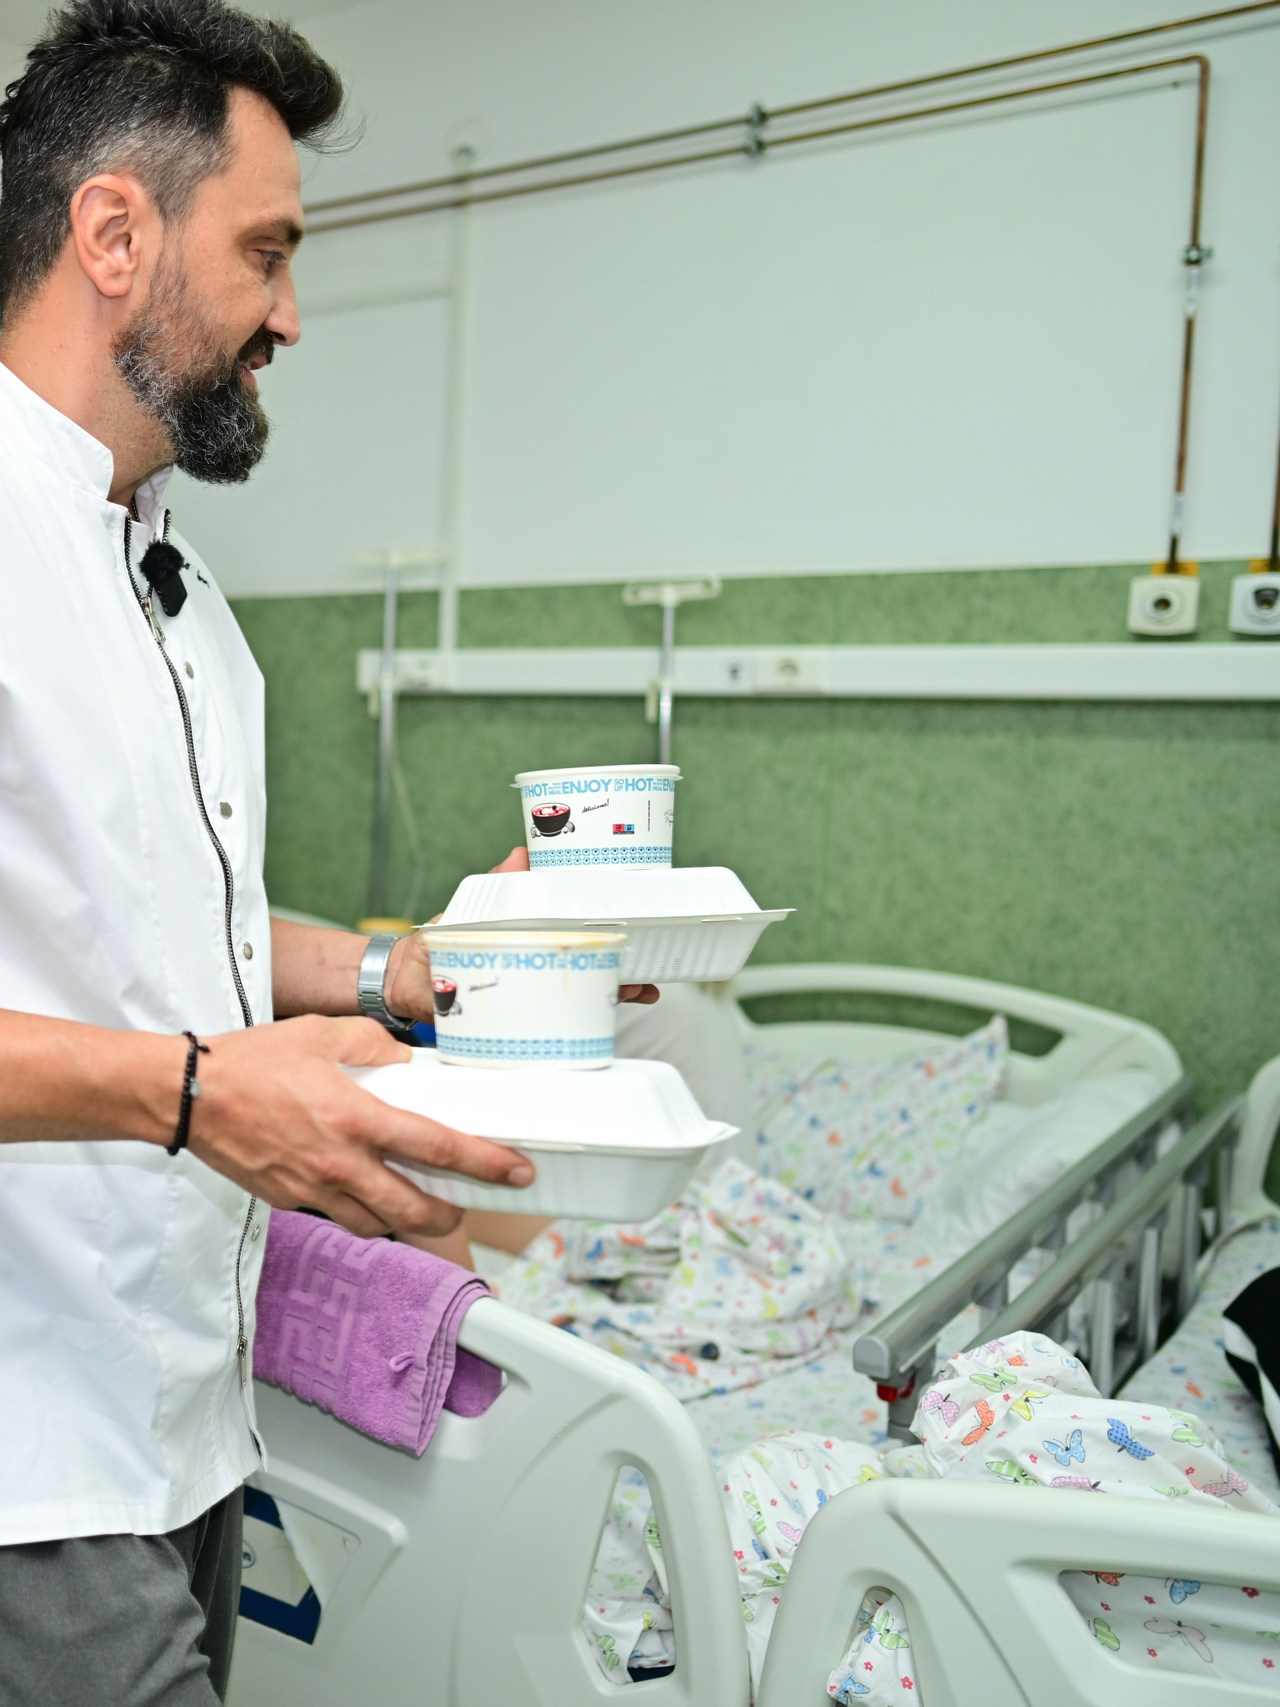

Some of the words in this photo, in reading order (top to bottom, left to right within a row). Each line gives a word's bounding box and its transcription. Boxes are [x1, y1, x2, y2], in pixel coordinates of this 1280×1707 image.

[527, 783, 549, 798] HOT
[562, 779, 612, 795] ENJOY
[625, 777, 654, 792] HOT
[614, 778, 625, 786] SO
[447, 952, 497, 968] ENJOY
[516, 953, 558, 970] HOT
